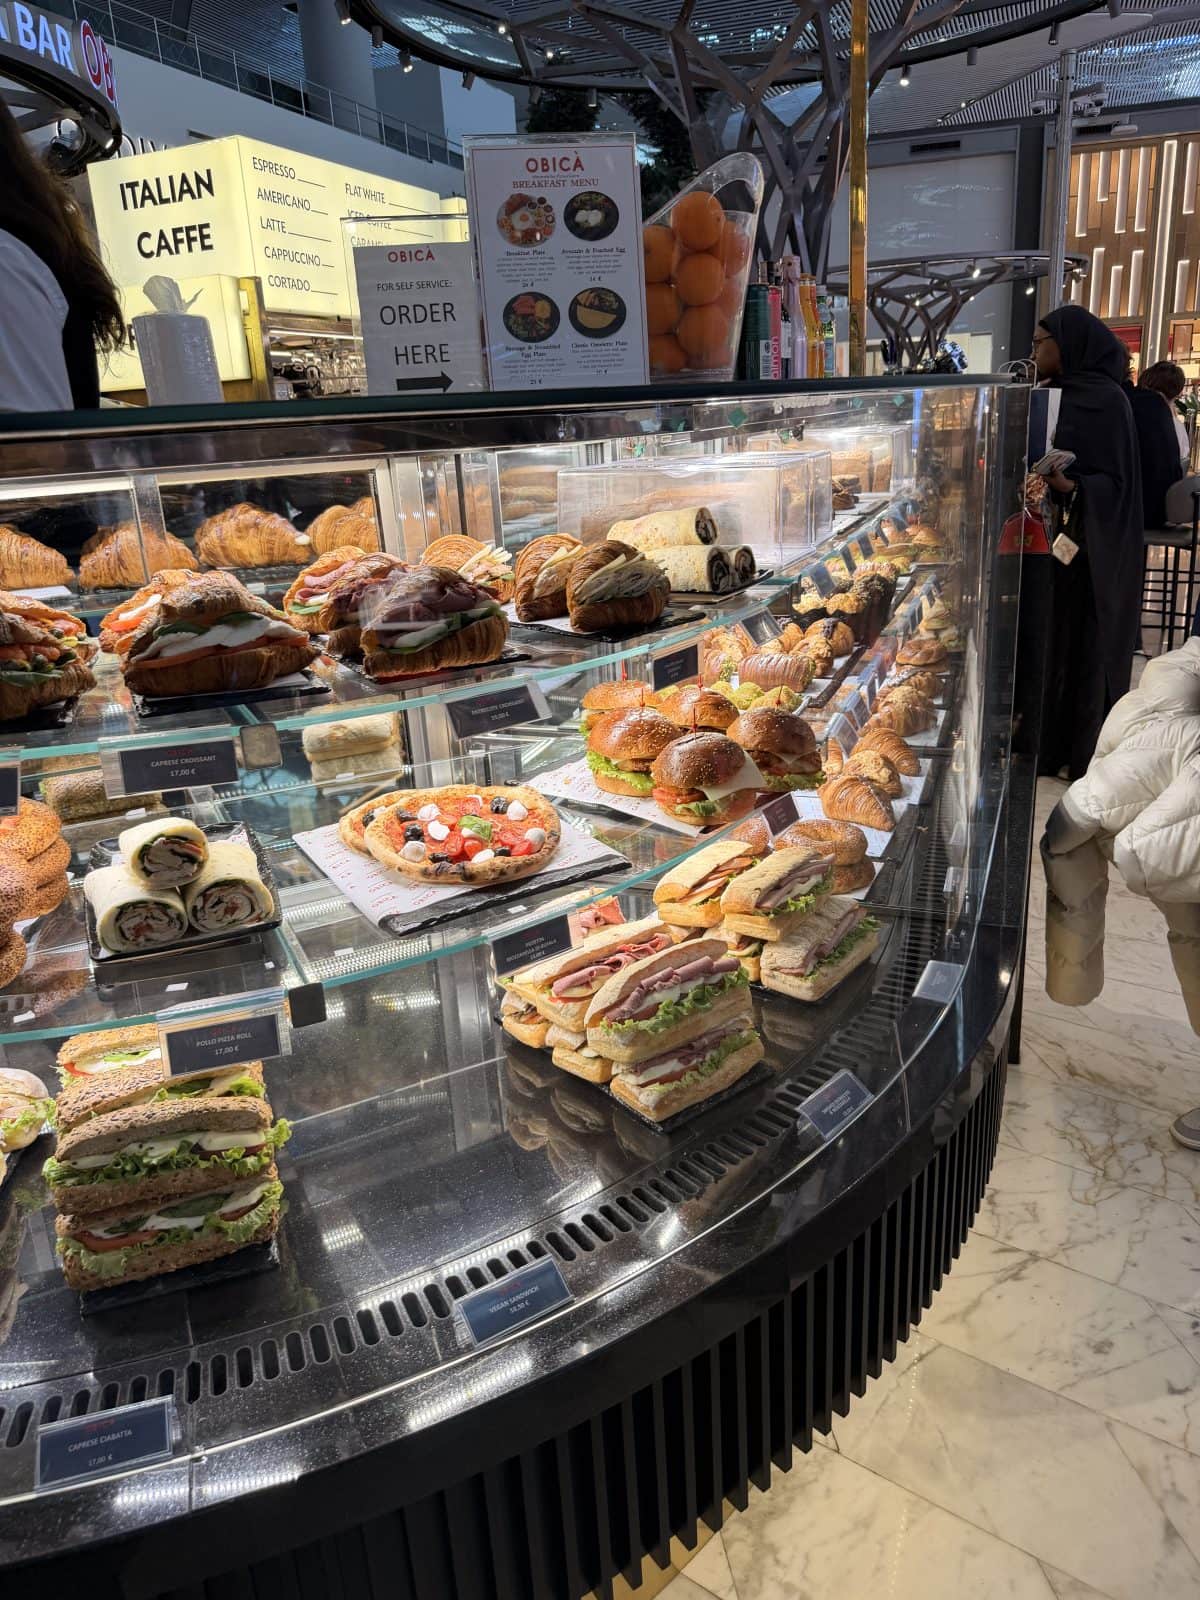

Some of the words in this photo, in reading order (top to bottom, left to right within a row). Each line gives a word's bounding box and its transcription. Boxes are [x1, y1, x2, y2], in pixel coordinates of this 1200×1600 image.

[14, 2, 74, 72] BAR
[252, 156, 295, 179] ESPRESSO
[526, 150, 584, 172] OBICÀ
[120, 169, 214, 210] ITALIAN
[345, 183, 362, 198] FLAT
[363, 188, 386, 204] WHITE
[512, 179, 567, 188] BREAKFAST
[571, 178, 599, 187] MENU
[257, 187, 311, 211] AMERICANO
[260, 216, 287, 233] LATTE
[137, 223, 213, 259] CAFFE
[264, 246, 321, 267] CAPPUCCINO
[388, 245, 435, 263] OBICÀ
[268, 275, 311, 291] CORTADO
[377, 283, 394, 291] FOR
[396, 282, 414, 291] SELF
[380, 302, 456, 325] ORDER
[394, 344, 451, 365] HERE
[151, 759, 180, 768] CAPRESE
[180, 755, 216, 764] CROISSANT
[170, 769, 190, 777] 17,00
[196, 1039, 217, 1047] POLLO
[217, 1036, 235, 1044] PIZZA
[236, 1032, 252, 1040] ROLL
[215, 1047, 234, 1056] 17,00
[68, 1437, 98, 1453] CAPRESE
[100, 1429, 132, 1444] CIABATTA
